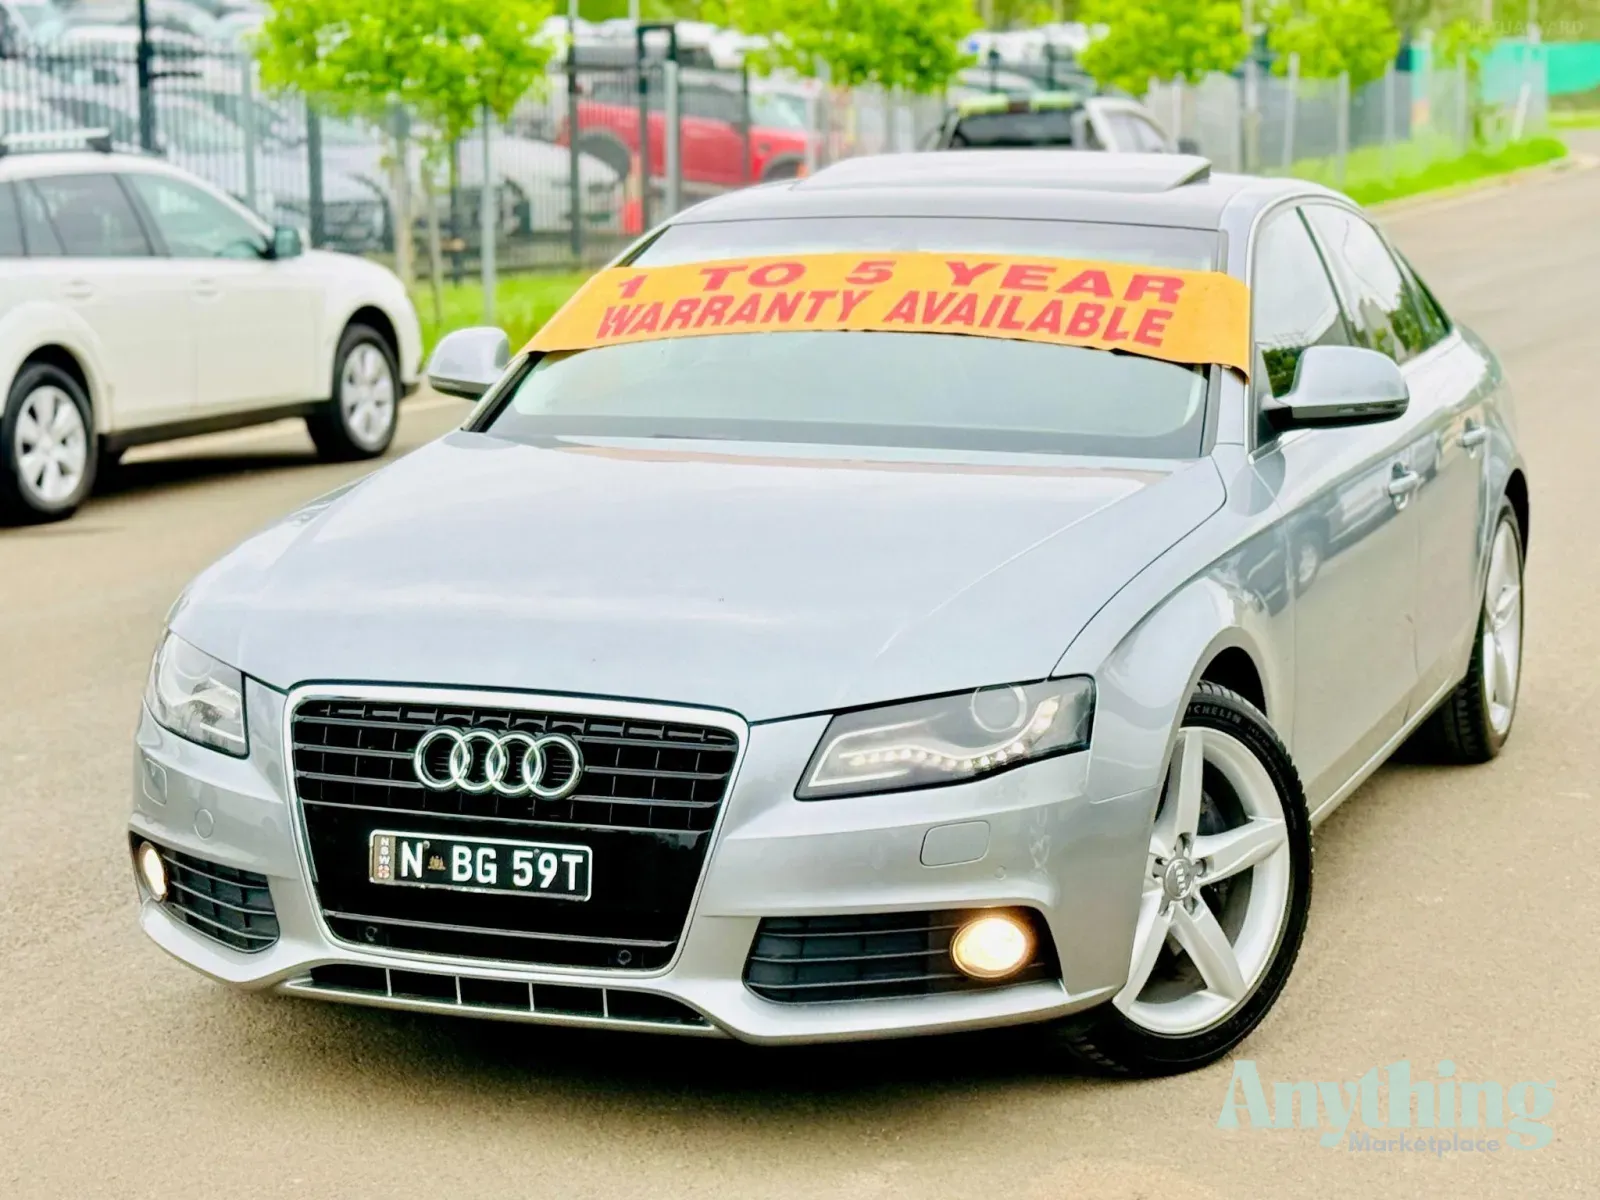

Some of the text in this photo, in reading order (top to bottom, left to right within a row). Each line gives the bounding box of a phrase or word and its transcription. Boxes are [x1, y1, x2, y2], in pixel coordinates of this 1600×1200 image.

[618, 260, 1186, 304] 1 TO 5 YEAR
[595, 290, 1174, 348] WARRANTY AVAILABLE
[1187, 704, 1242, 723] ICHELIN
[400, 840, 584, 892] N BG 59T
